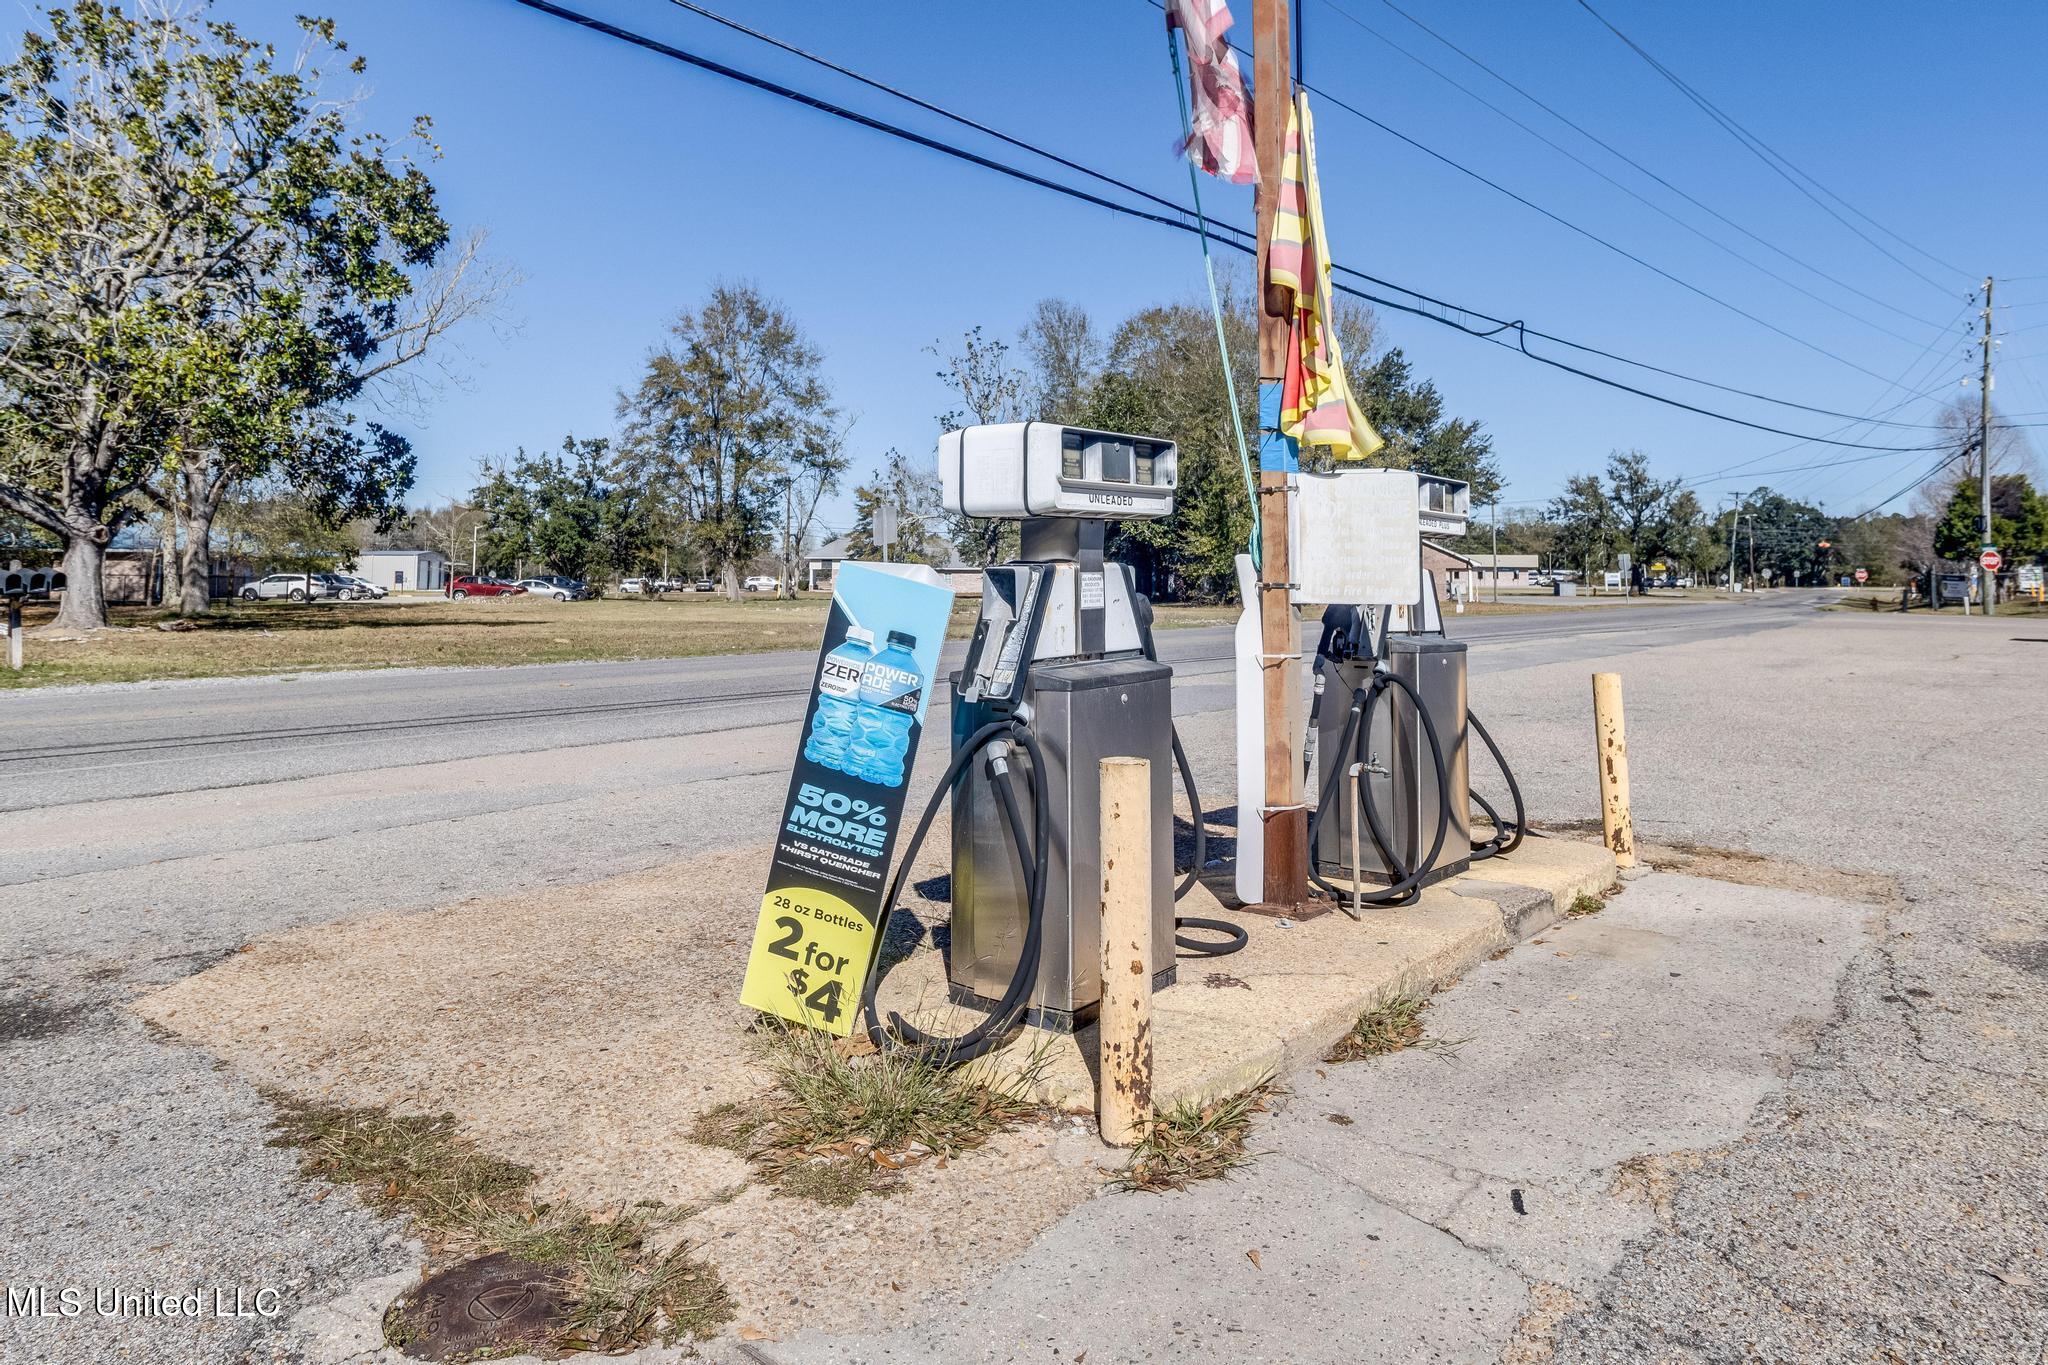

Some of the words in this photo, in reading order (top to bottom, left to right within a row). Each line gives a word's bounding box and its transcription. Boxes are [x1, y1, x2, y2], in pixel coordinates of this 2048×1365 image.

[1089, 494, 1133, 506] UNLEADED
[1438, 521, 1450, 531] PLUS
[1981, 556, 2000, 565] STOP
[821, 681, 837, 691] ZERO
[861, 675, 892, 691] ADE
[864, 662, 919, 687] POWER
[797, 782, 887, 826] 50%
[789, 804, 888, 849] MORE
[780, 843, 818, 862] THIRST
[819, 854, 881, 880] QUENCHER
[793, 840, 809, 851] VS
[810, 844, 871, 868] GATORADE
[773, 895, 790, 910] 28
[794, 903, 811, 917] oz
[814, 908, 864, 933] Bottles
[767, 916, 804, 962] 2
[804, 941, 850, 976] for
